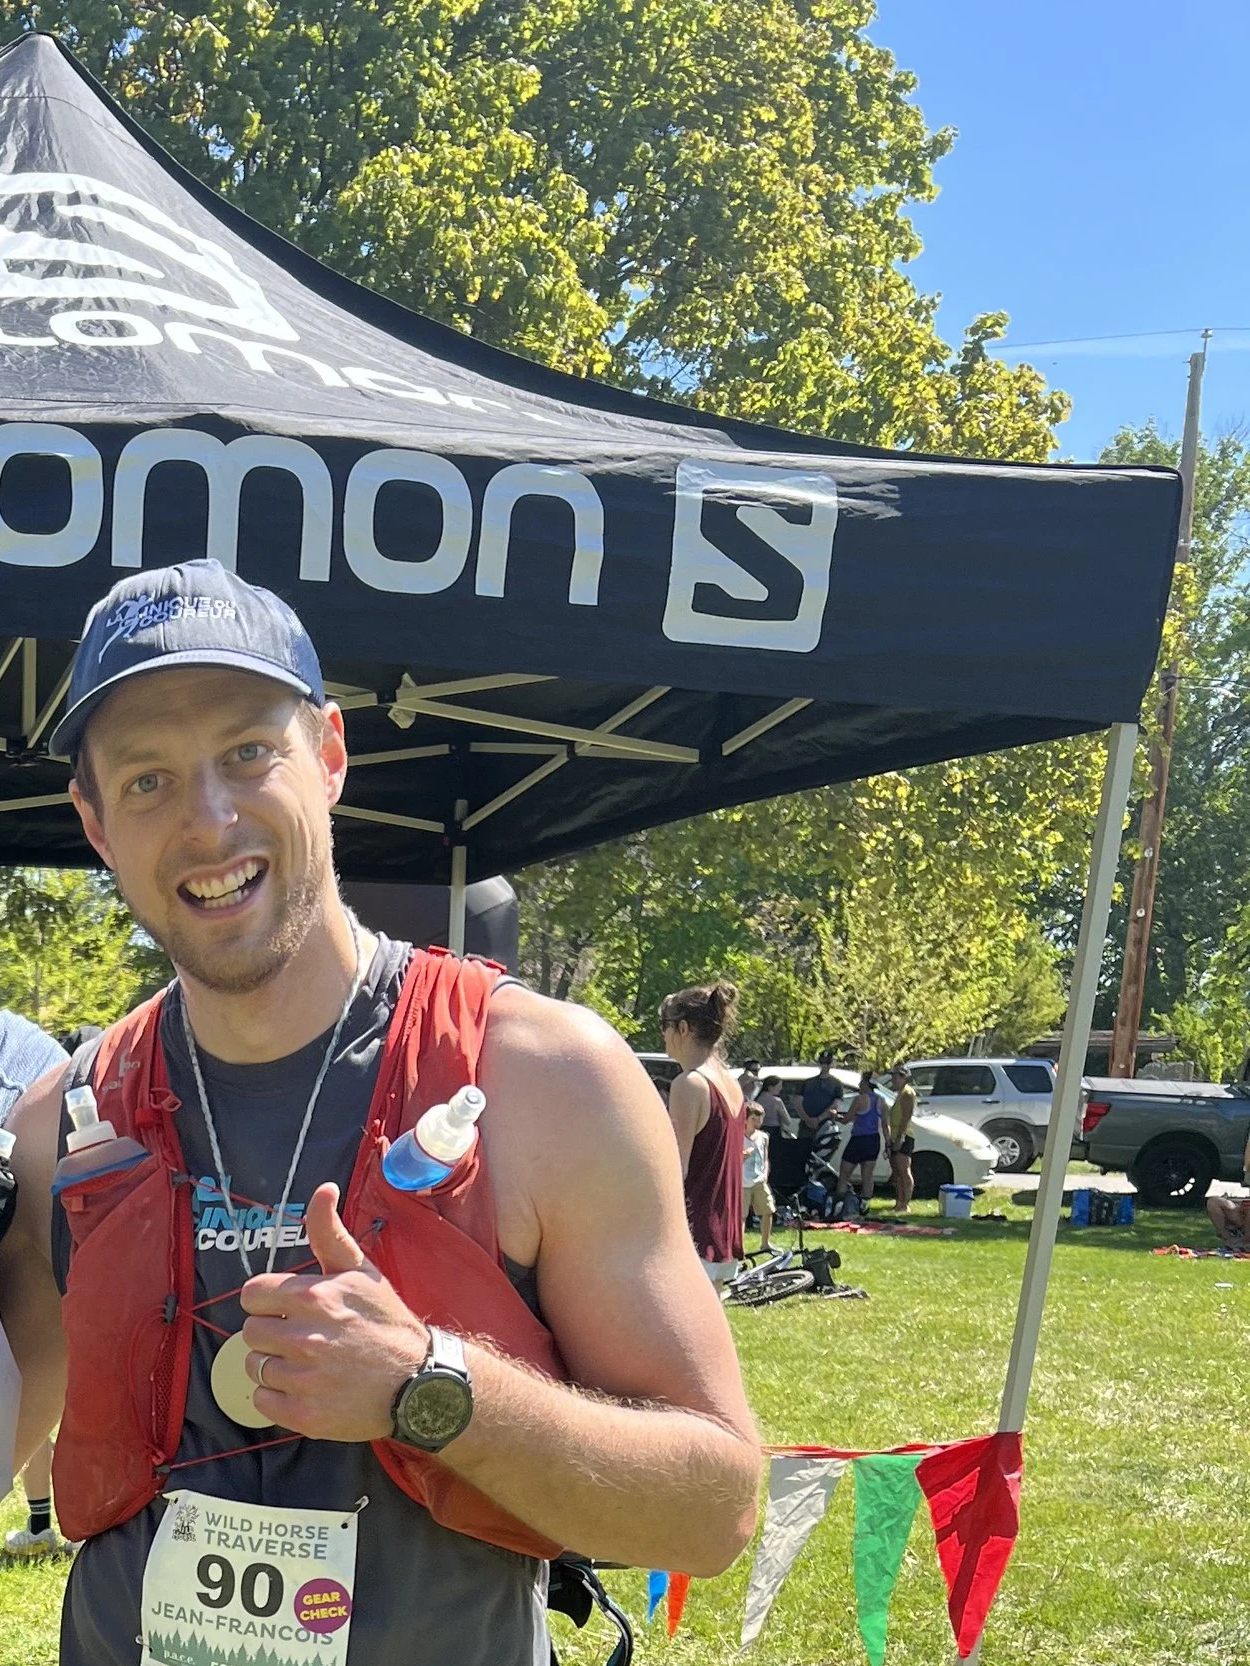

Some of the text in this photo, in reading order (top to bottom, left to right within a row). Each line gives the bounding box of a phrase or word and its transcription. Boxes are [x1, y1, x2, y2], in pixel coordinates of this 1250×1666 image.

[205, 1511, 329, 1541] WILD HORSE
[204, 1528, 327, 1560] TRAVERSE
[196, 1554, 284, 1618] 90
[302, 1591, 341, 1606] GEAR
[151, 1601, 334, 1645] JEAN-FRANCOIS
[300, 1605, 348, 1621] CHECK
